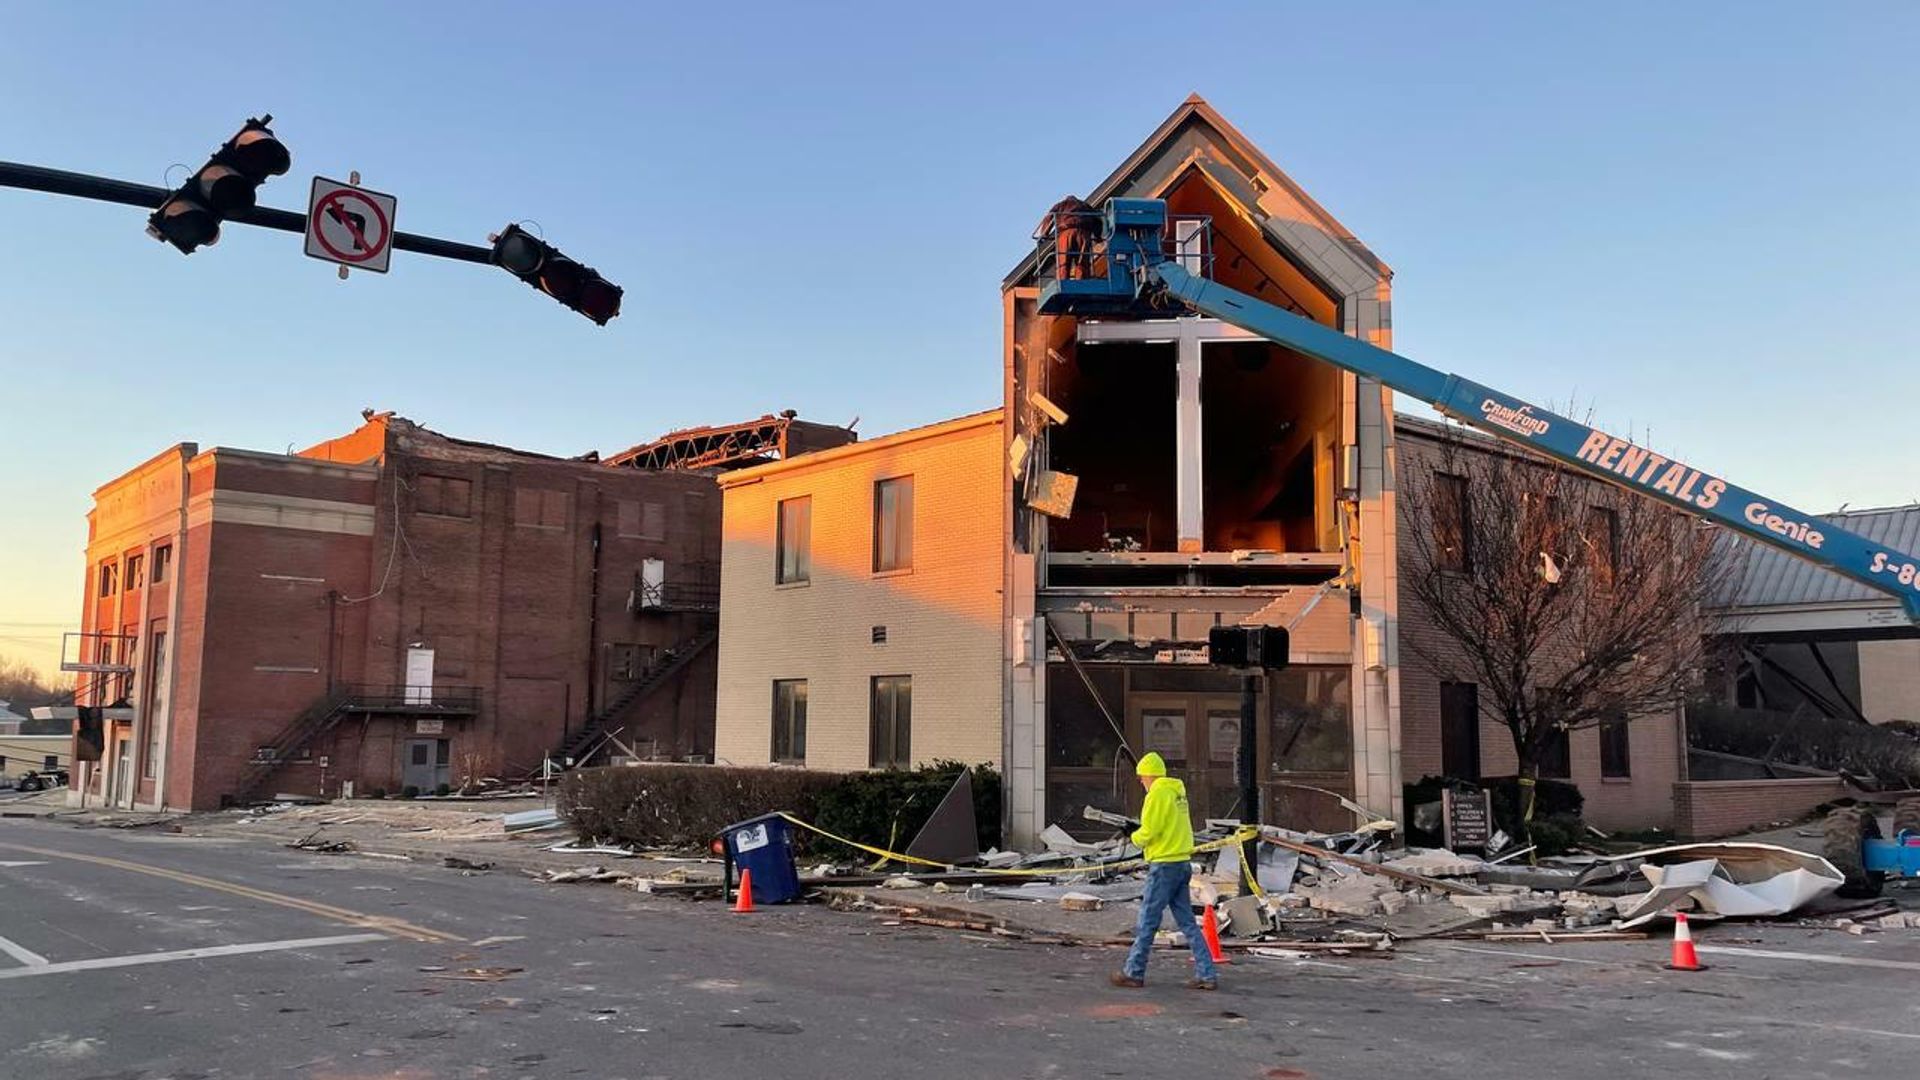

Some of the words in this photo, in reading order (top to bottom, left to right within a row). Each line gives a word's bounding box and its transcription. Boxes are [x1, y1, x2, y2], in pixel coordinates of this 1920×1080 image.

[1481, 399, 1549, 434] CRAWFORD
[1576, 429, 1726, 509] RENTALS
[1744, 502, 1825, 549] Genie
